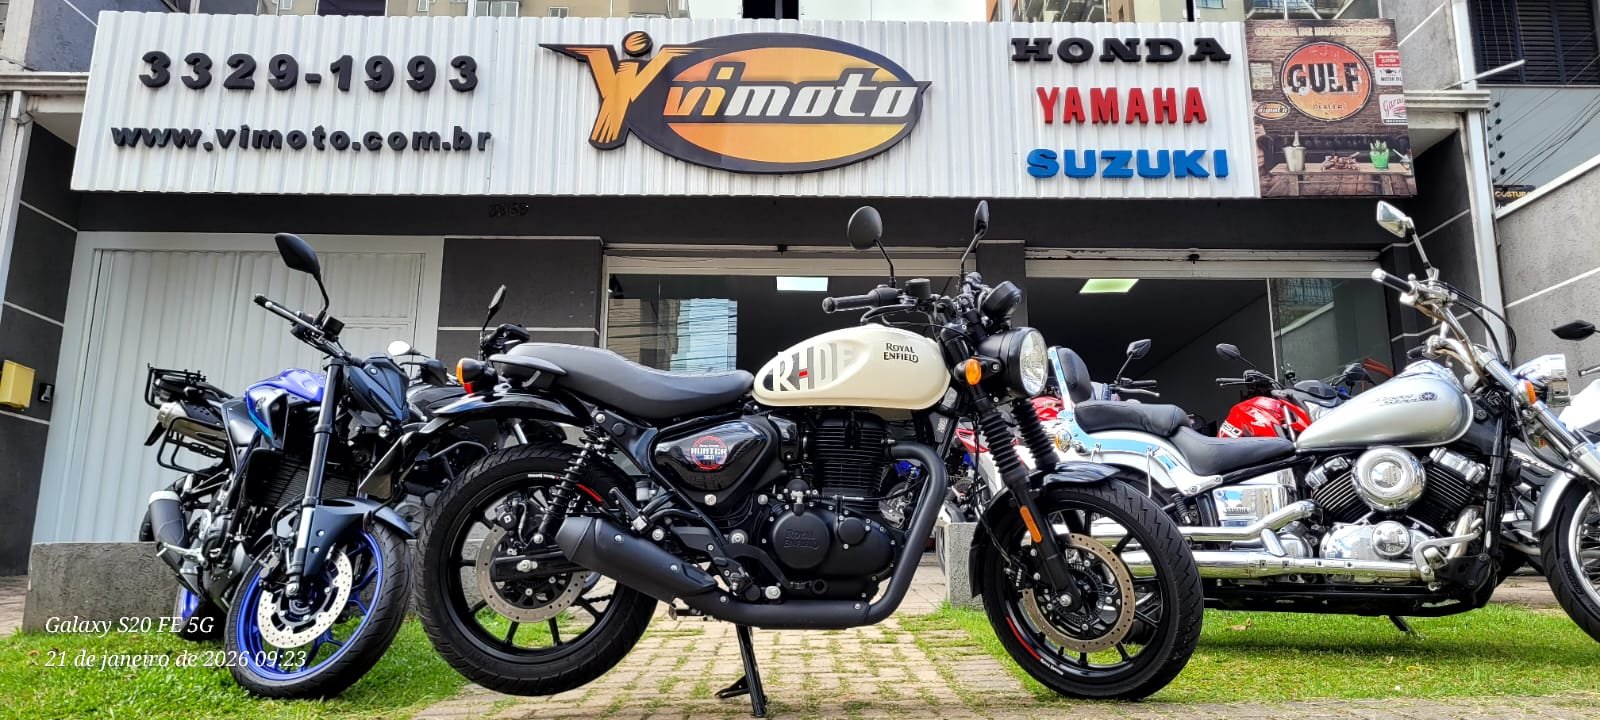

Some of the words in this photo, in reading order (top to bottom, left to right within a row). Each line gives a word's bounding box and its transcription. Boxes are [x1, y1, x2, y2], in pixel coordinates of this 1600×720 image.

[1011, 38, 1231, 63] HONDA
[139, 50, 479, 92] 3329-1993
[1287, 62, 1361, 93] GULF
[663, 66, 917, 118] vimoto
[1036, 87, 1208, 124] YAMAHA
[111, 124, 492, 152] www.vimoto.com.br
[1027, 149, 1229, 178] SUZUKI
[883, 351, 919, 363] ENFIELD
[886, 342, 915, 353] ROYAL
